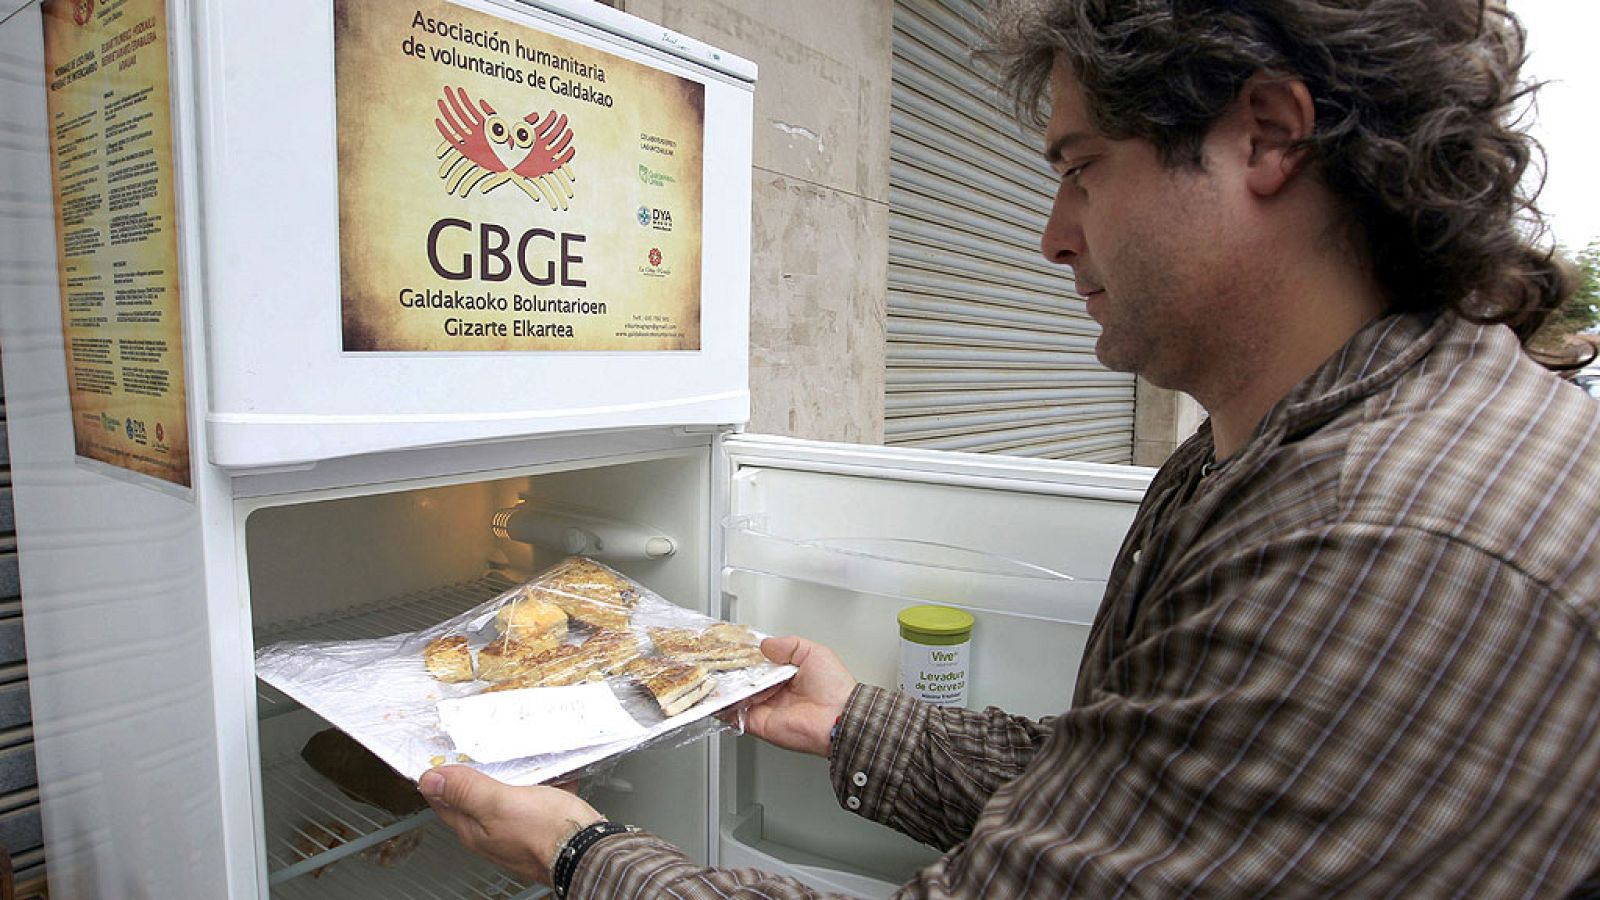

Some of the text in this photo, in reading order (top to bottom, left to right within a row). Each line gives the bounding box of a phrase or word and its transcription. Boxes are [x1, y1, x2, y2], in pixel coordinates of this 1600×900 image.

[411, 10, 606, 83] Asociación humanitaria
[402, 36, 613, 109] de voluntarios de Galdakao
[653, 208, 672, 222] DYA
[427, 218, 587, 288] GBGE
[399, 288, 607, 315] Galdakaoko Boluntarioen
[444, 318, 574, 338] Gizarte Elkartea
[915, 682, 926, 690] de
